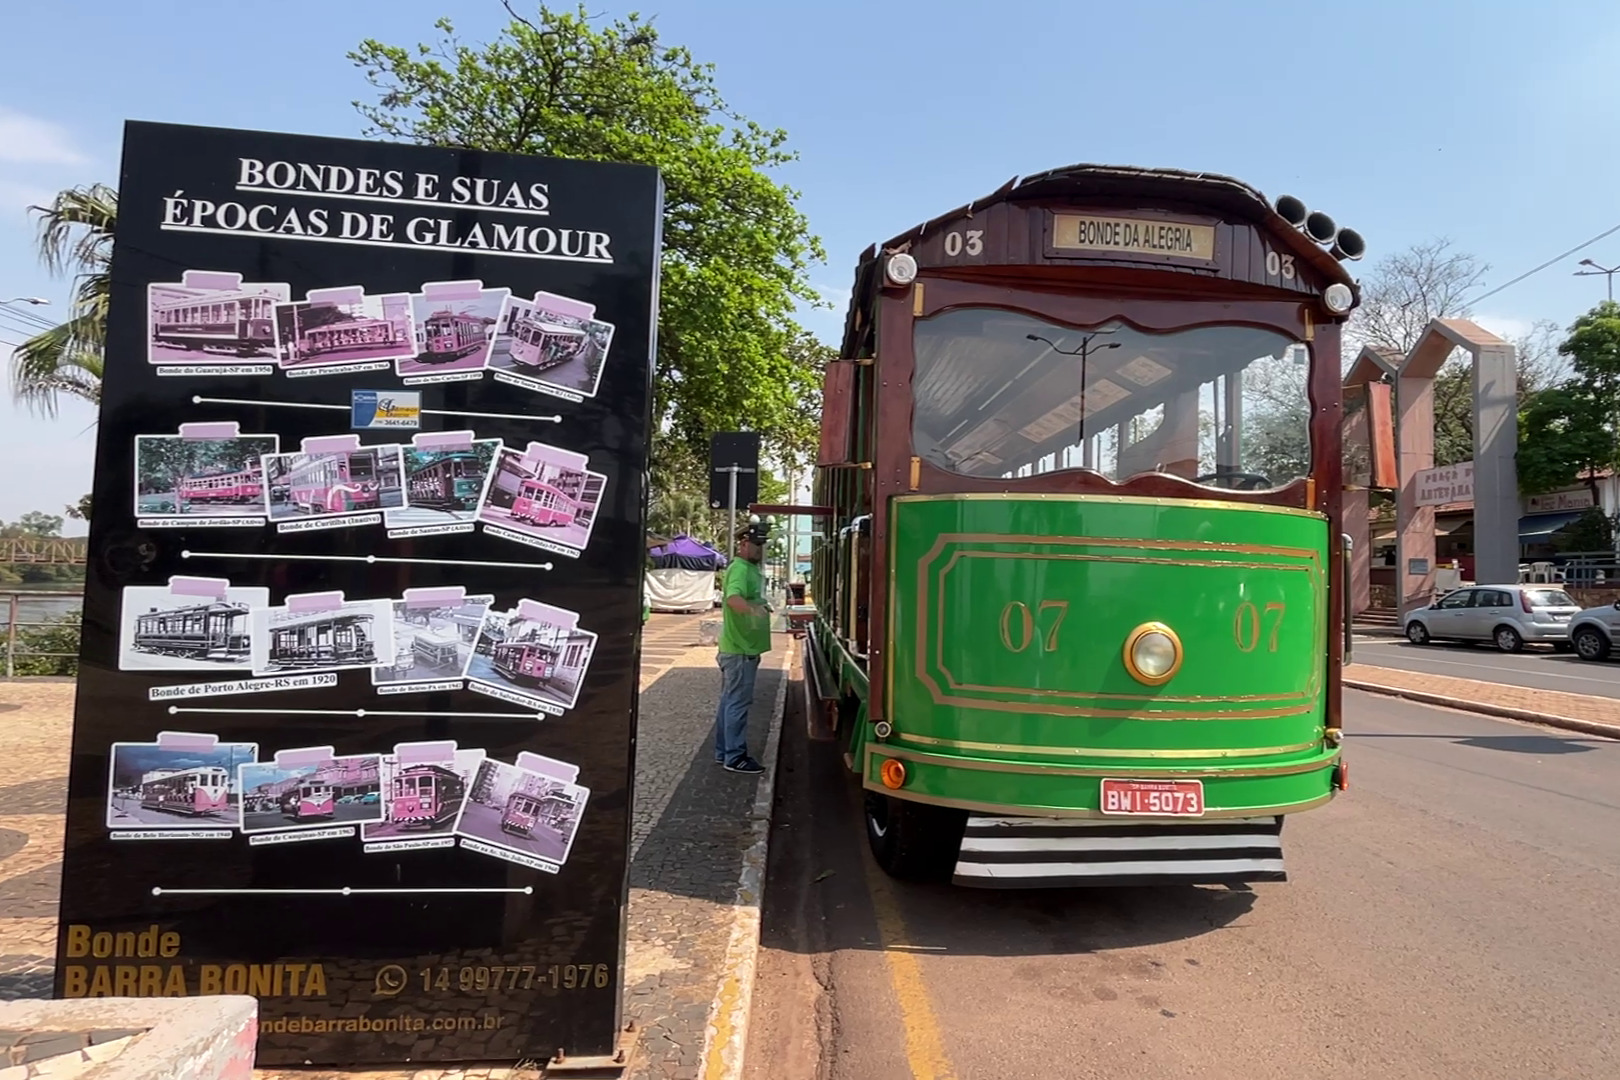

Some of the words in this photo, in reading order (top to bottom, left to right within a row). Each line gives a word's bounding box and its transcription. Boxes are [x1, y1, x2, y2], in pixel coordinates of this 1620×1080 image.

[238, 158, 403, 198] BONDES
[415, 173, 439, 200] E
[451, 176, 550, 210] SUAS
[163, 189, 328, 237] ÉPOCAS
[340, 211, 394, 243] DE
[406, 217, 612, 259] GLAMOUR
[1078, 220, 1120, 246] BONDE
[1124, 223, 1141, 248] DA
[1142, 225, 1193, 252] ALEGRIA
[944, 229, 984, 257] 03
[1266, 251, 1295, 279] 03
[280, 522, 303, 530] Bonde
[315, 519, 346, 527] Curitiba
[1000, 599, 1070, 653] 07
[1233, 602, 1286, 653] 07
[152, 688, 186, 698] Bonde
[188, 686, 201, 694] de
[204, 683, 234, 693] Porto
[235, 678, 290, 692] Alegre-RS
[293, 677, 309, 686] em
[312, 674, 336, 684] 1920
[66, 924, 181, 958] Bonde
[64, 965, 187, 998] BARRA
[200, 963, 327, 997] BONITA
[420, 967, 449, 992] 14
[459, 963, 609, 991] 99777-1976
[260, 1014, 505, 1034] ndebarrabonita.com.br
